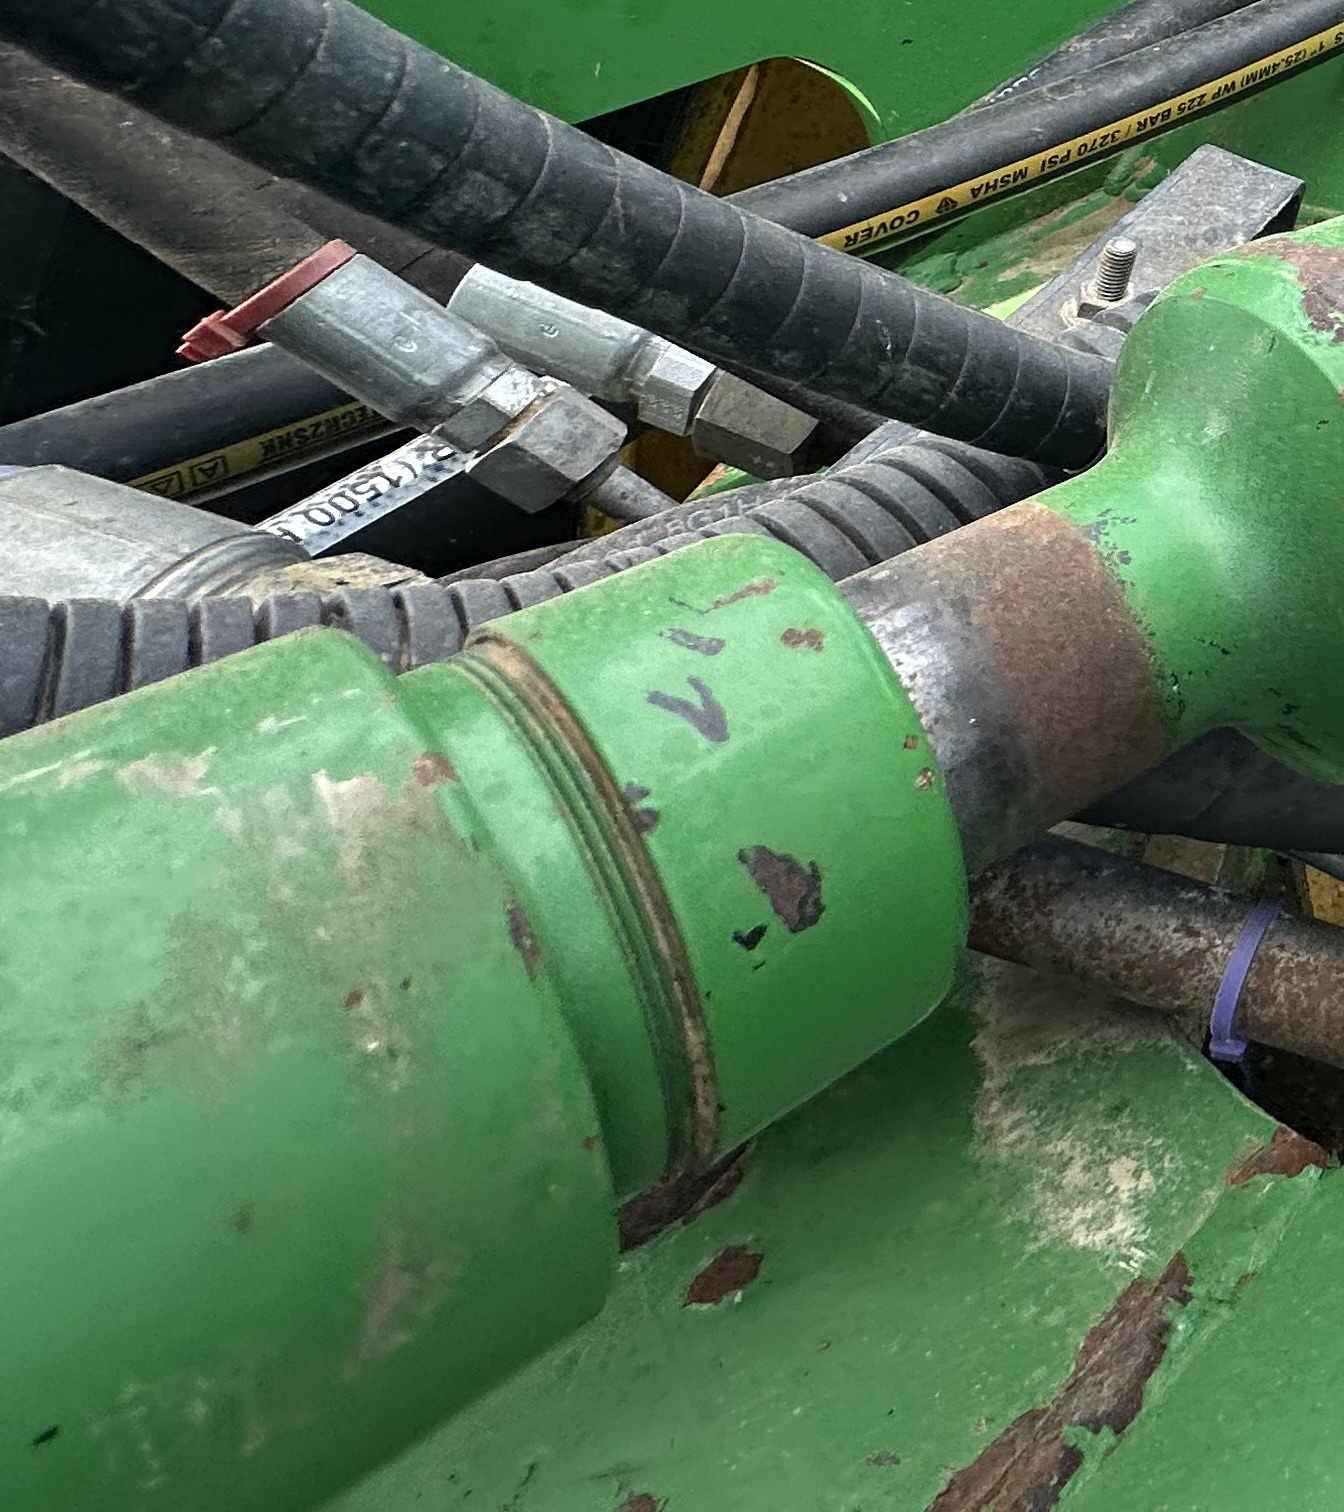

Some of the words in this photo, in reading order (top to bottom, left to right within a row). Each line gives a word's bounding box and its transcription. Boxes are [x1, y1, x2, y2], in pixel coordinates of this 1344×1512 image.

[1240, 47, 1307, 88] (25.4MM)
[1176, 91, 1208, 116] 225
[1211, 79, 1237, 100] WP
[1136, 106, 1173, 133] BAR
[1077, 128, 1122, 157] 3270
[1040, 148, 1072, 172] PSI
[969, 166, 1030, 199] MSHA
[843, 209, 921, 248] COVER
